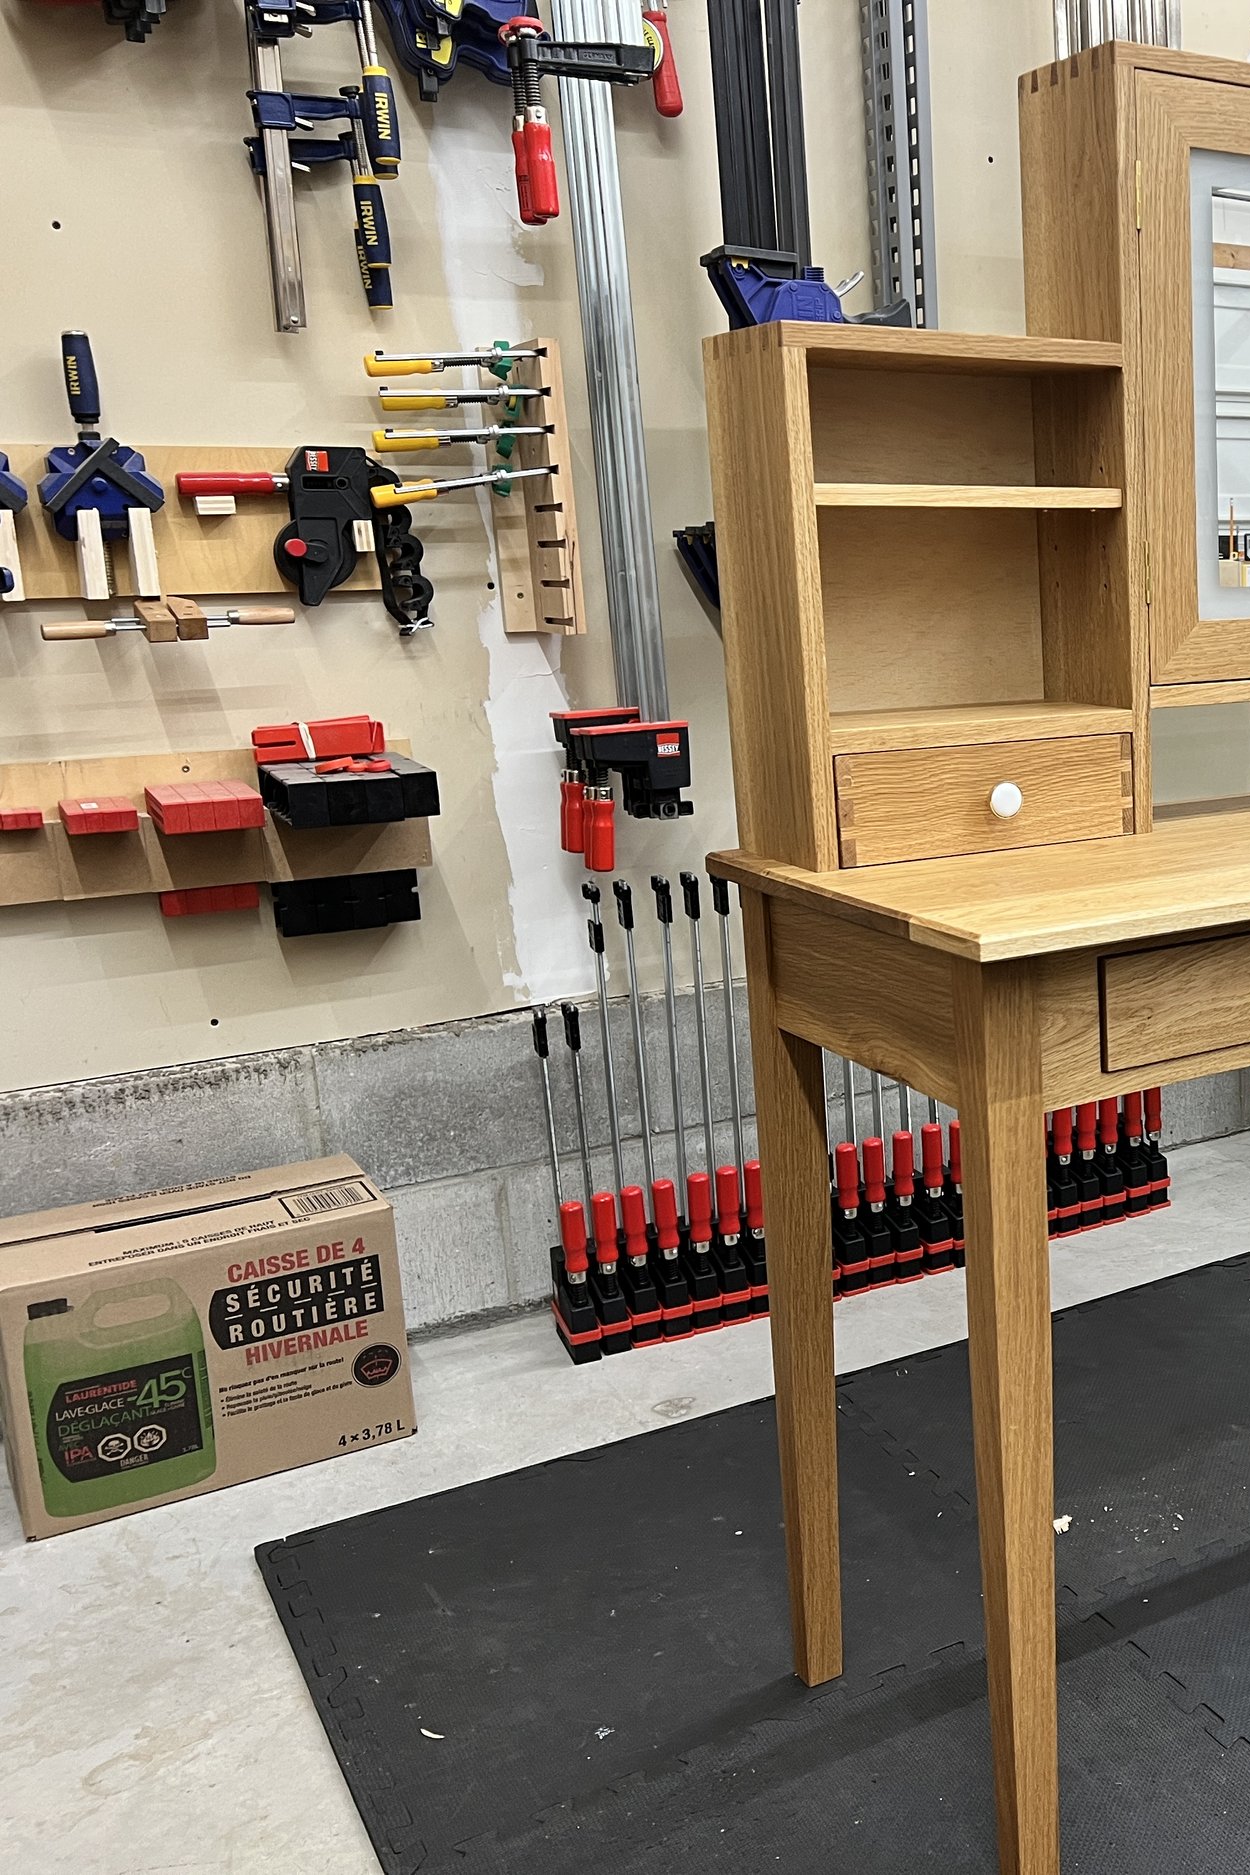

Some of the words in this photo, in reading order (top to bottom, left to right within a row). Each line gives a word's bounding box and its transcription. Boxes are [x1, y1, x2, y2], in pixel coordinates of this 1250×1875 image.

[374, 92, 392, 140] IRWIN
[360, 200, 379, 246] IRWIN
[357, 245, 373, 289] IRWIN
[66, 355, 81, 395] IRWIN
[88, 1250, 155, 1267] ENTREPOSER
[157, 1244, 185, 1253] DANS
[203, 1231, 246, 1244] ENDROIT
[248, 1224, 277, 1234] FRAIS
[122, 1241, 174, 1255] MAXIMUM
[190, 1229, 232, 1241] CAISSES
[249, 1220, 275, 1229] HAUT
[227, 1249, 310, 1283] CAISSE
[316, 1241, 345, 1264] DE
[352, 1237, 366, 1255] 4
[226, 1259, 374, 1313] SÉCURITÉ
[228, 1291, 377, 1344] ROUTIÈRE
[245, 1319, 369, 1366] HIVERNALE
[65, 1379, 138, 1404] LAURENTIDE
[279, 1366, 308, 1378] manquer
[55, 1397, 125, 1422] LAVE-GLACE
[57, 1406, 152, 1438] DÉGLAÇANT
[338, 1435, 348, 1447] 4
[362, 1422, 393, 1441] 3,78
[396, 1419, 405, 1431] L
[64, 1445, 94, 1466] IPA
[120, 1453, 149, 1468] DANGER
